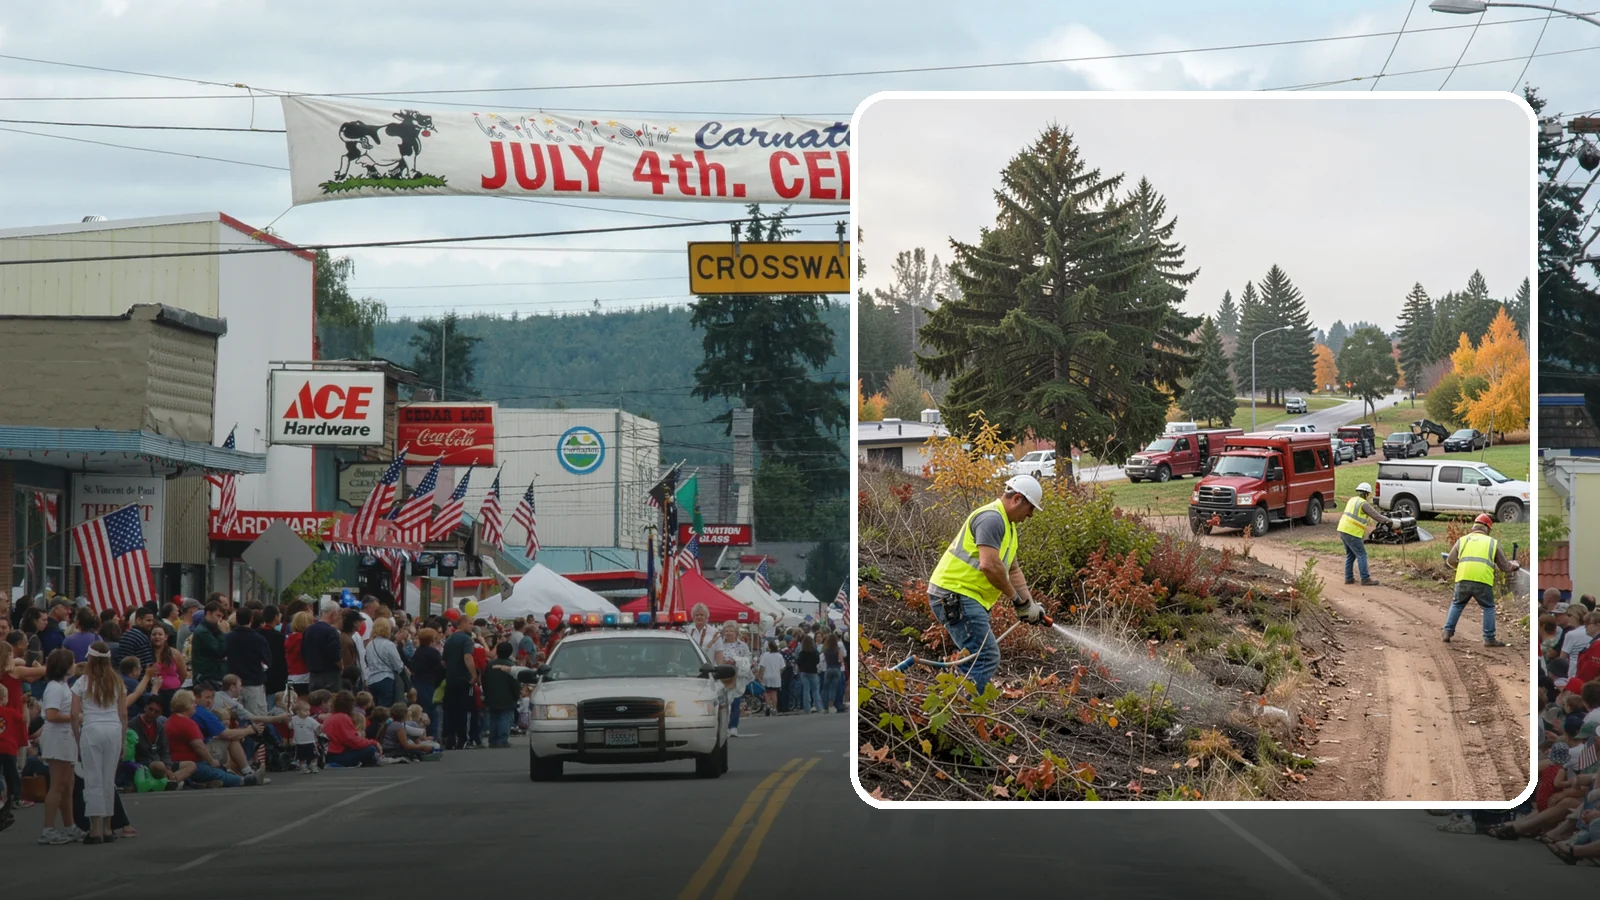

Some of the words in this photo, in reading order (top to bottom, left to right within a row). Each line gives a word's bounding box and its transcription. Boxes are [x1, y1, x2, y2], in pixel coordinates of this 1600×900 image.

[481, 141, 605, 192] JULY
[632, 150, 746, 197] 4th.
[697, 254, 850, 280] CROSSWA
[283, 380, 373, 420] ACE
[405, 409, 452, 422] CEDAR
[283, 421, 370, 437] Hardware
[354, 467, 385, 481] Simpl
[96, 485, 124, 494] Vincent
[126, 486, 136, 495] de
[137, 486, 155, 495] Paul
[688, 526, 741, 535] CRNATION
[699, 535, 730, 543] GLASS
